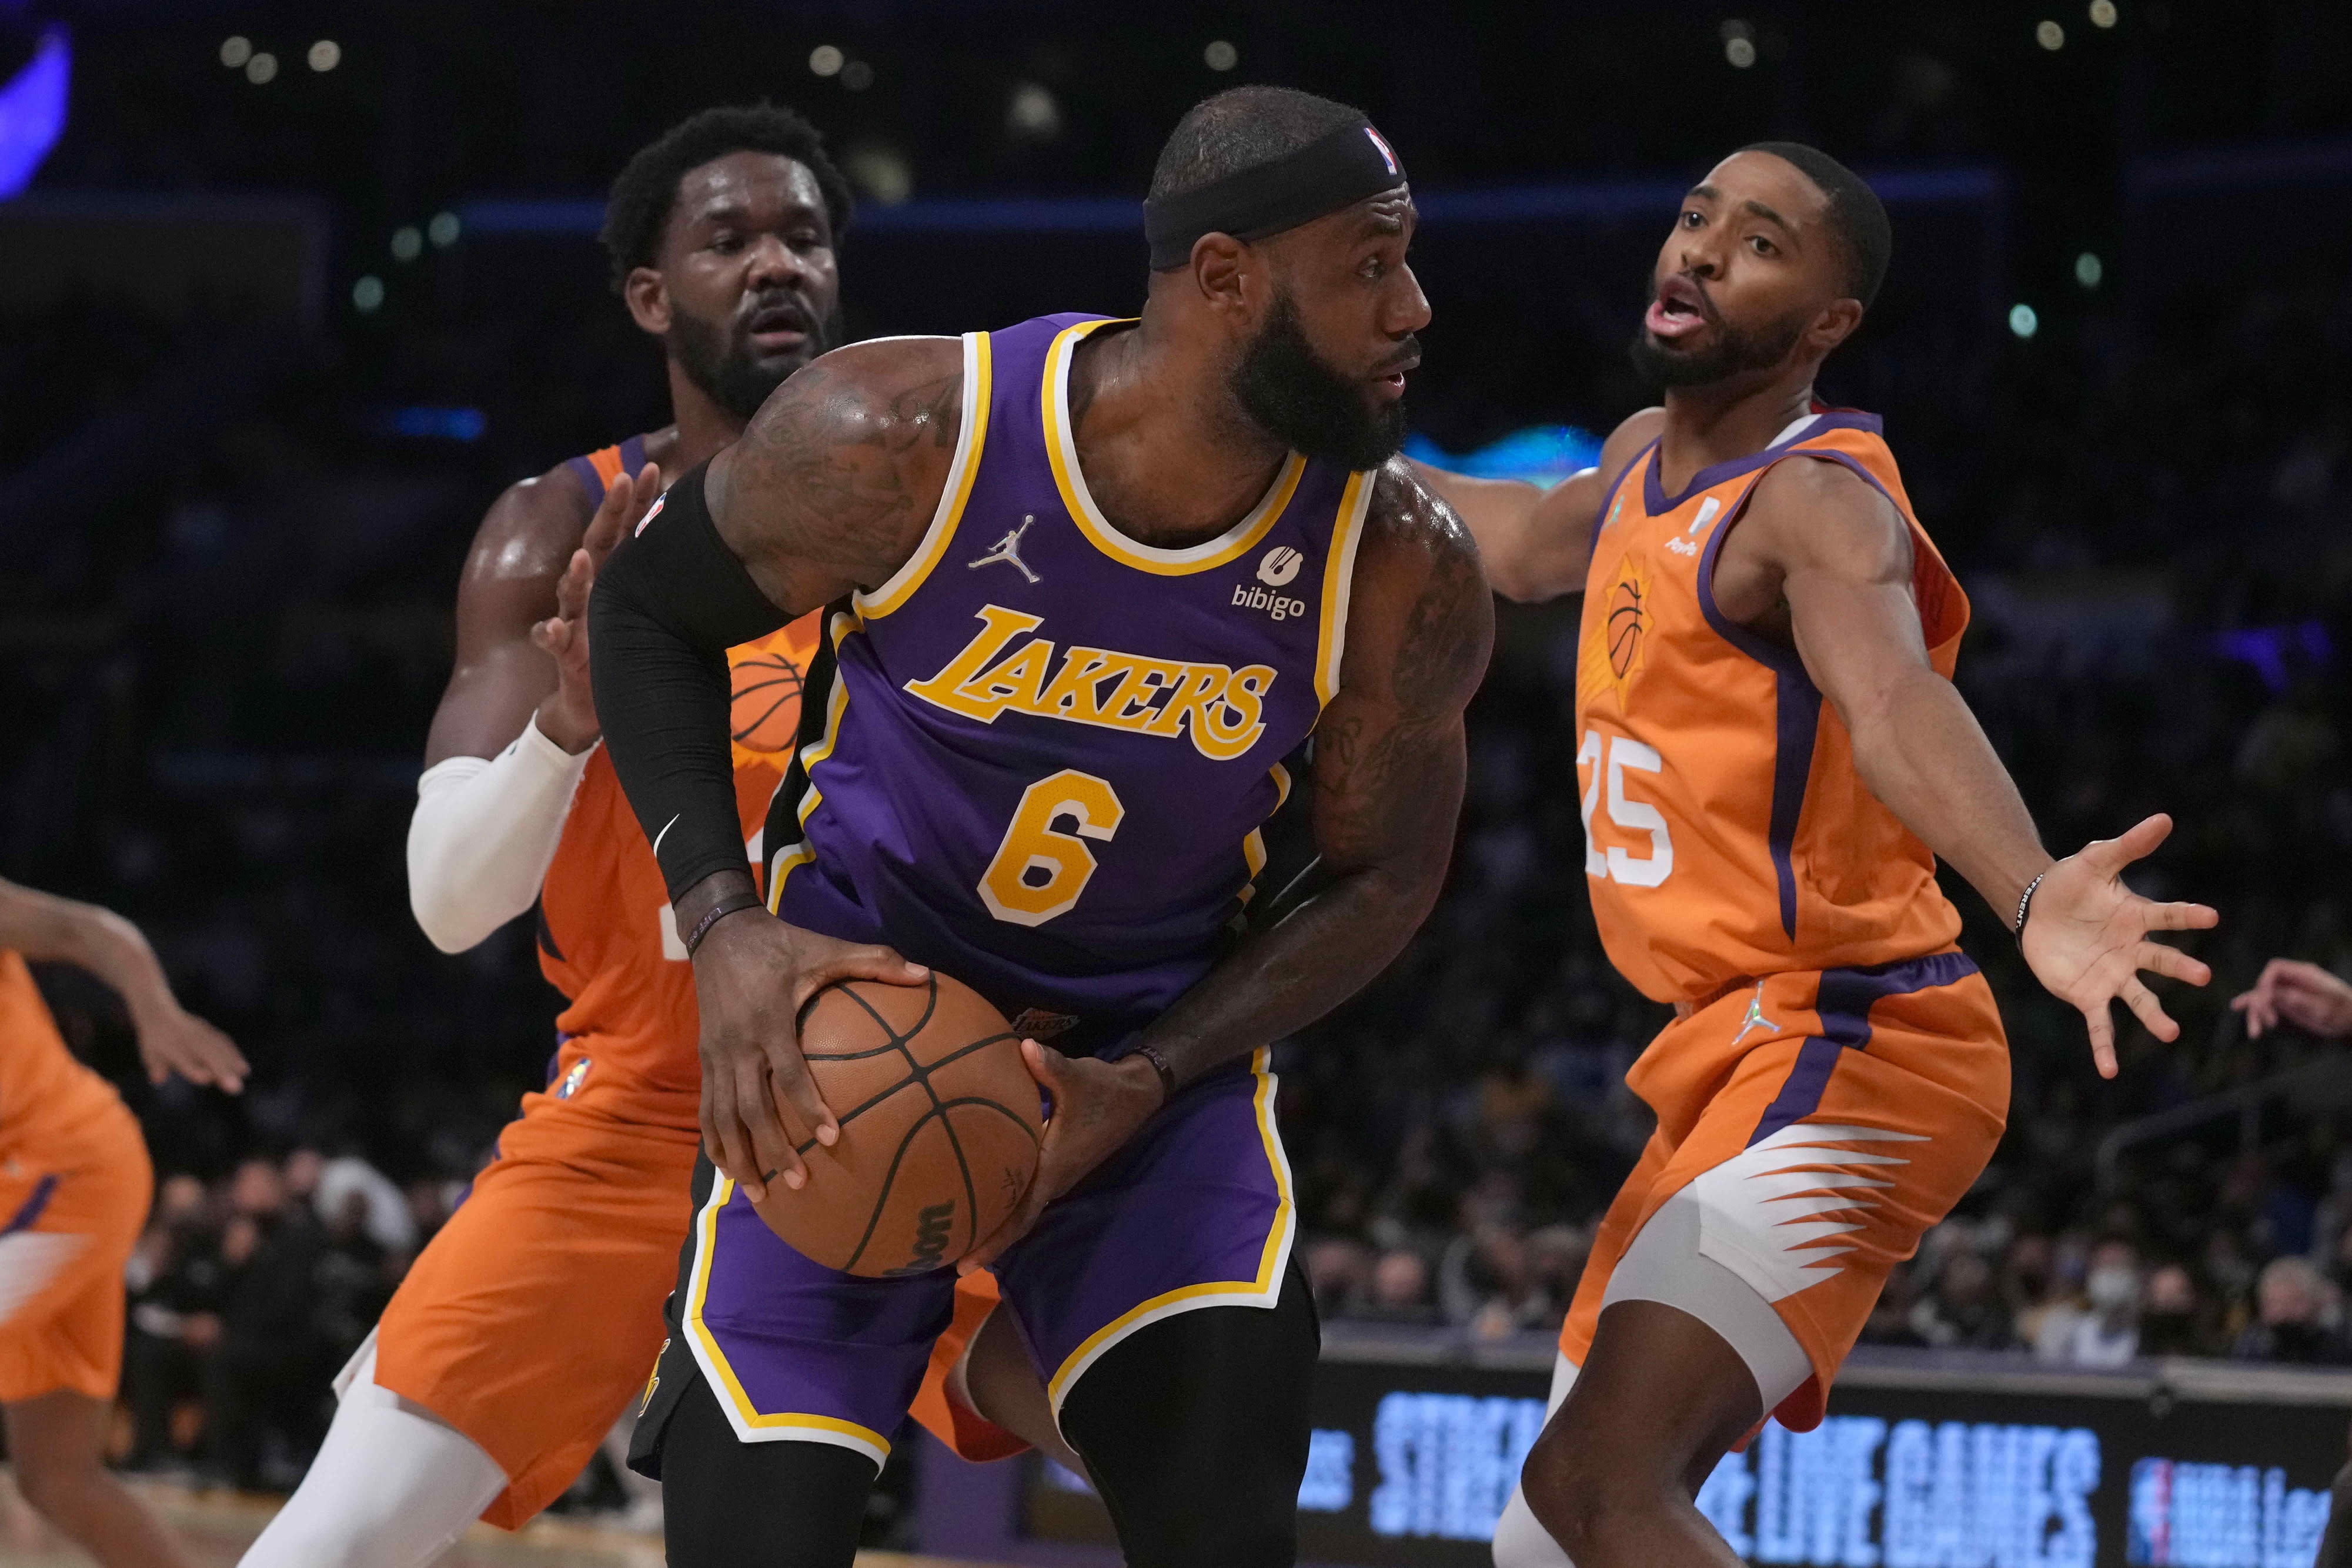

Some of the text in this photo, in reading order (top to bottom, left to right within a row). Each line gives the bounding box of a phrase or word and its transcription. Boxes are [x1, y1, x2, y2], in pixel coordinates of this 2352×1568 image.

[1231, 584, 1305, 621] bibigo
[902, 603, 1278, 761] LAKERS
[977, 768, 1125, 927] 6
